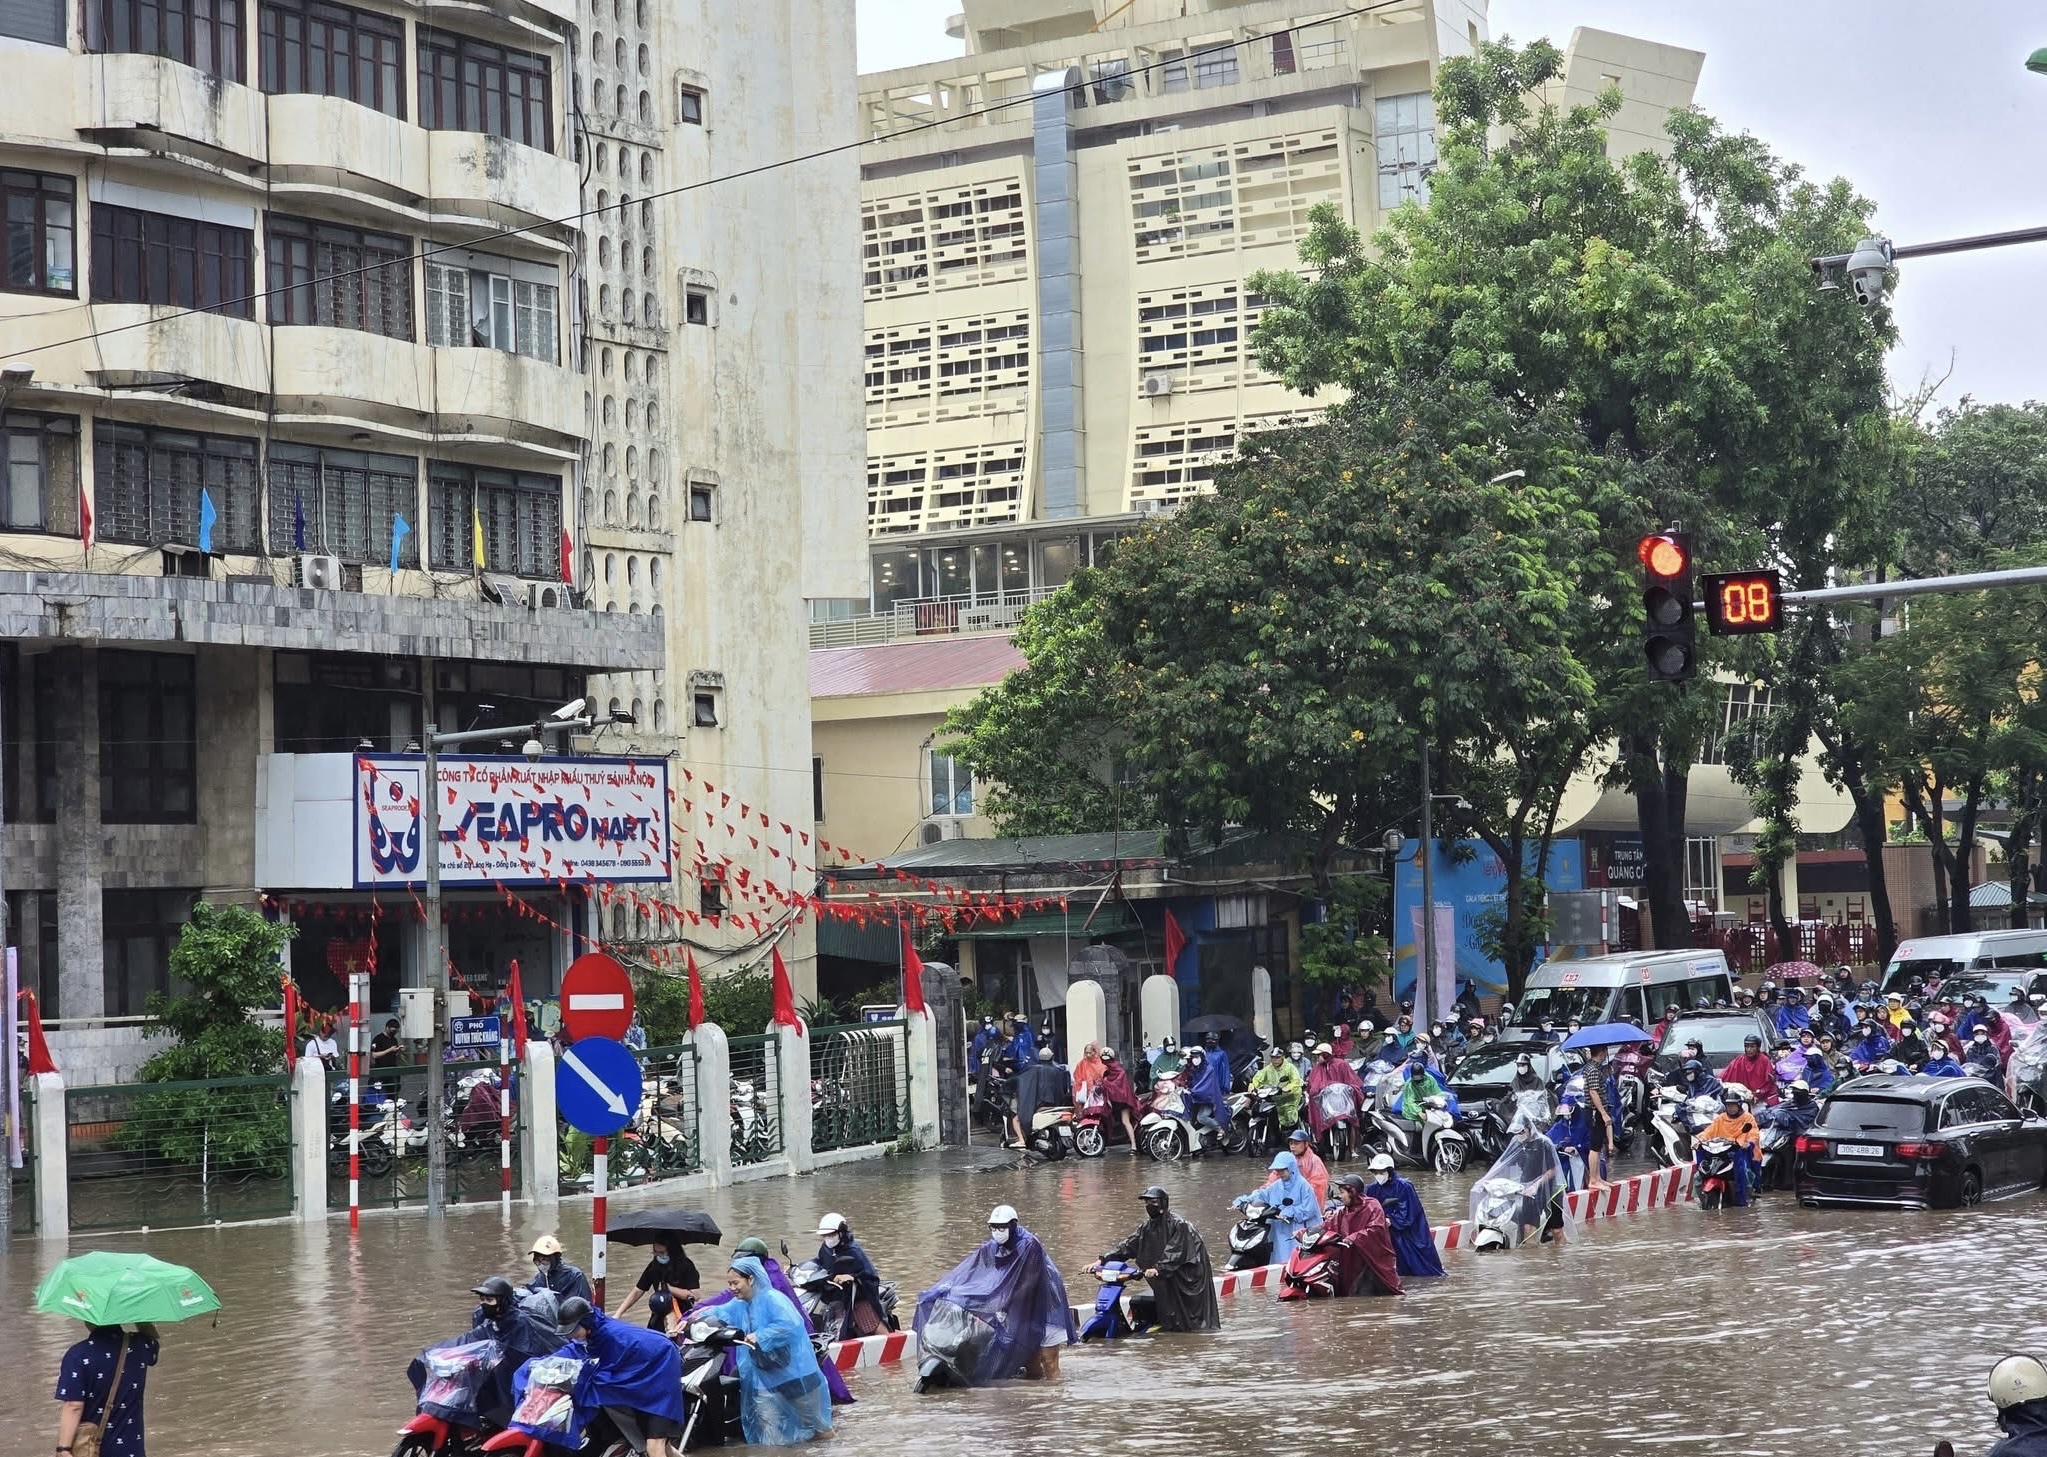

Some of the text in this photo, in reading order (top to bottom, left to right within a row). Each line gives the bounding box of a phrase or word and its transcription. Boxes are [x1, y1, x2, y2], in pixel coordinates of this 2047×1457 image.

[1725, 583, 1769, 622] 08
[437, 768, 460, 782] CÔNG
[476, 765, 488, 782] CỔ
[538, 770, 559, 786] NHẬP
[636, 771, 654, 788] NỘ
[591, 817, 650, 841] MART
[1614, 850, 1632, 860] TRUNG
[1608, 861, 1634, 879] QUẢNG
[468, 1019, 484, 1029] PHỐ
